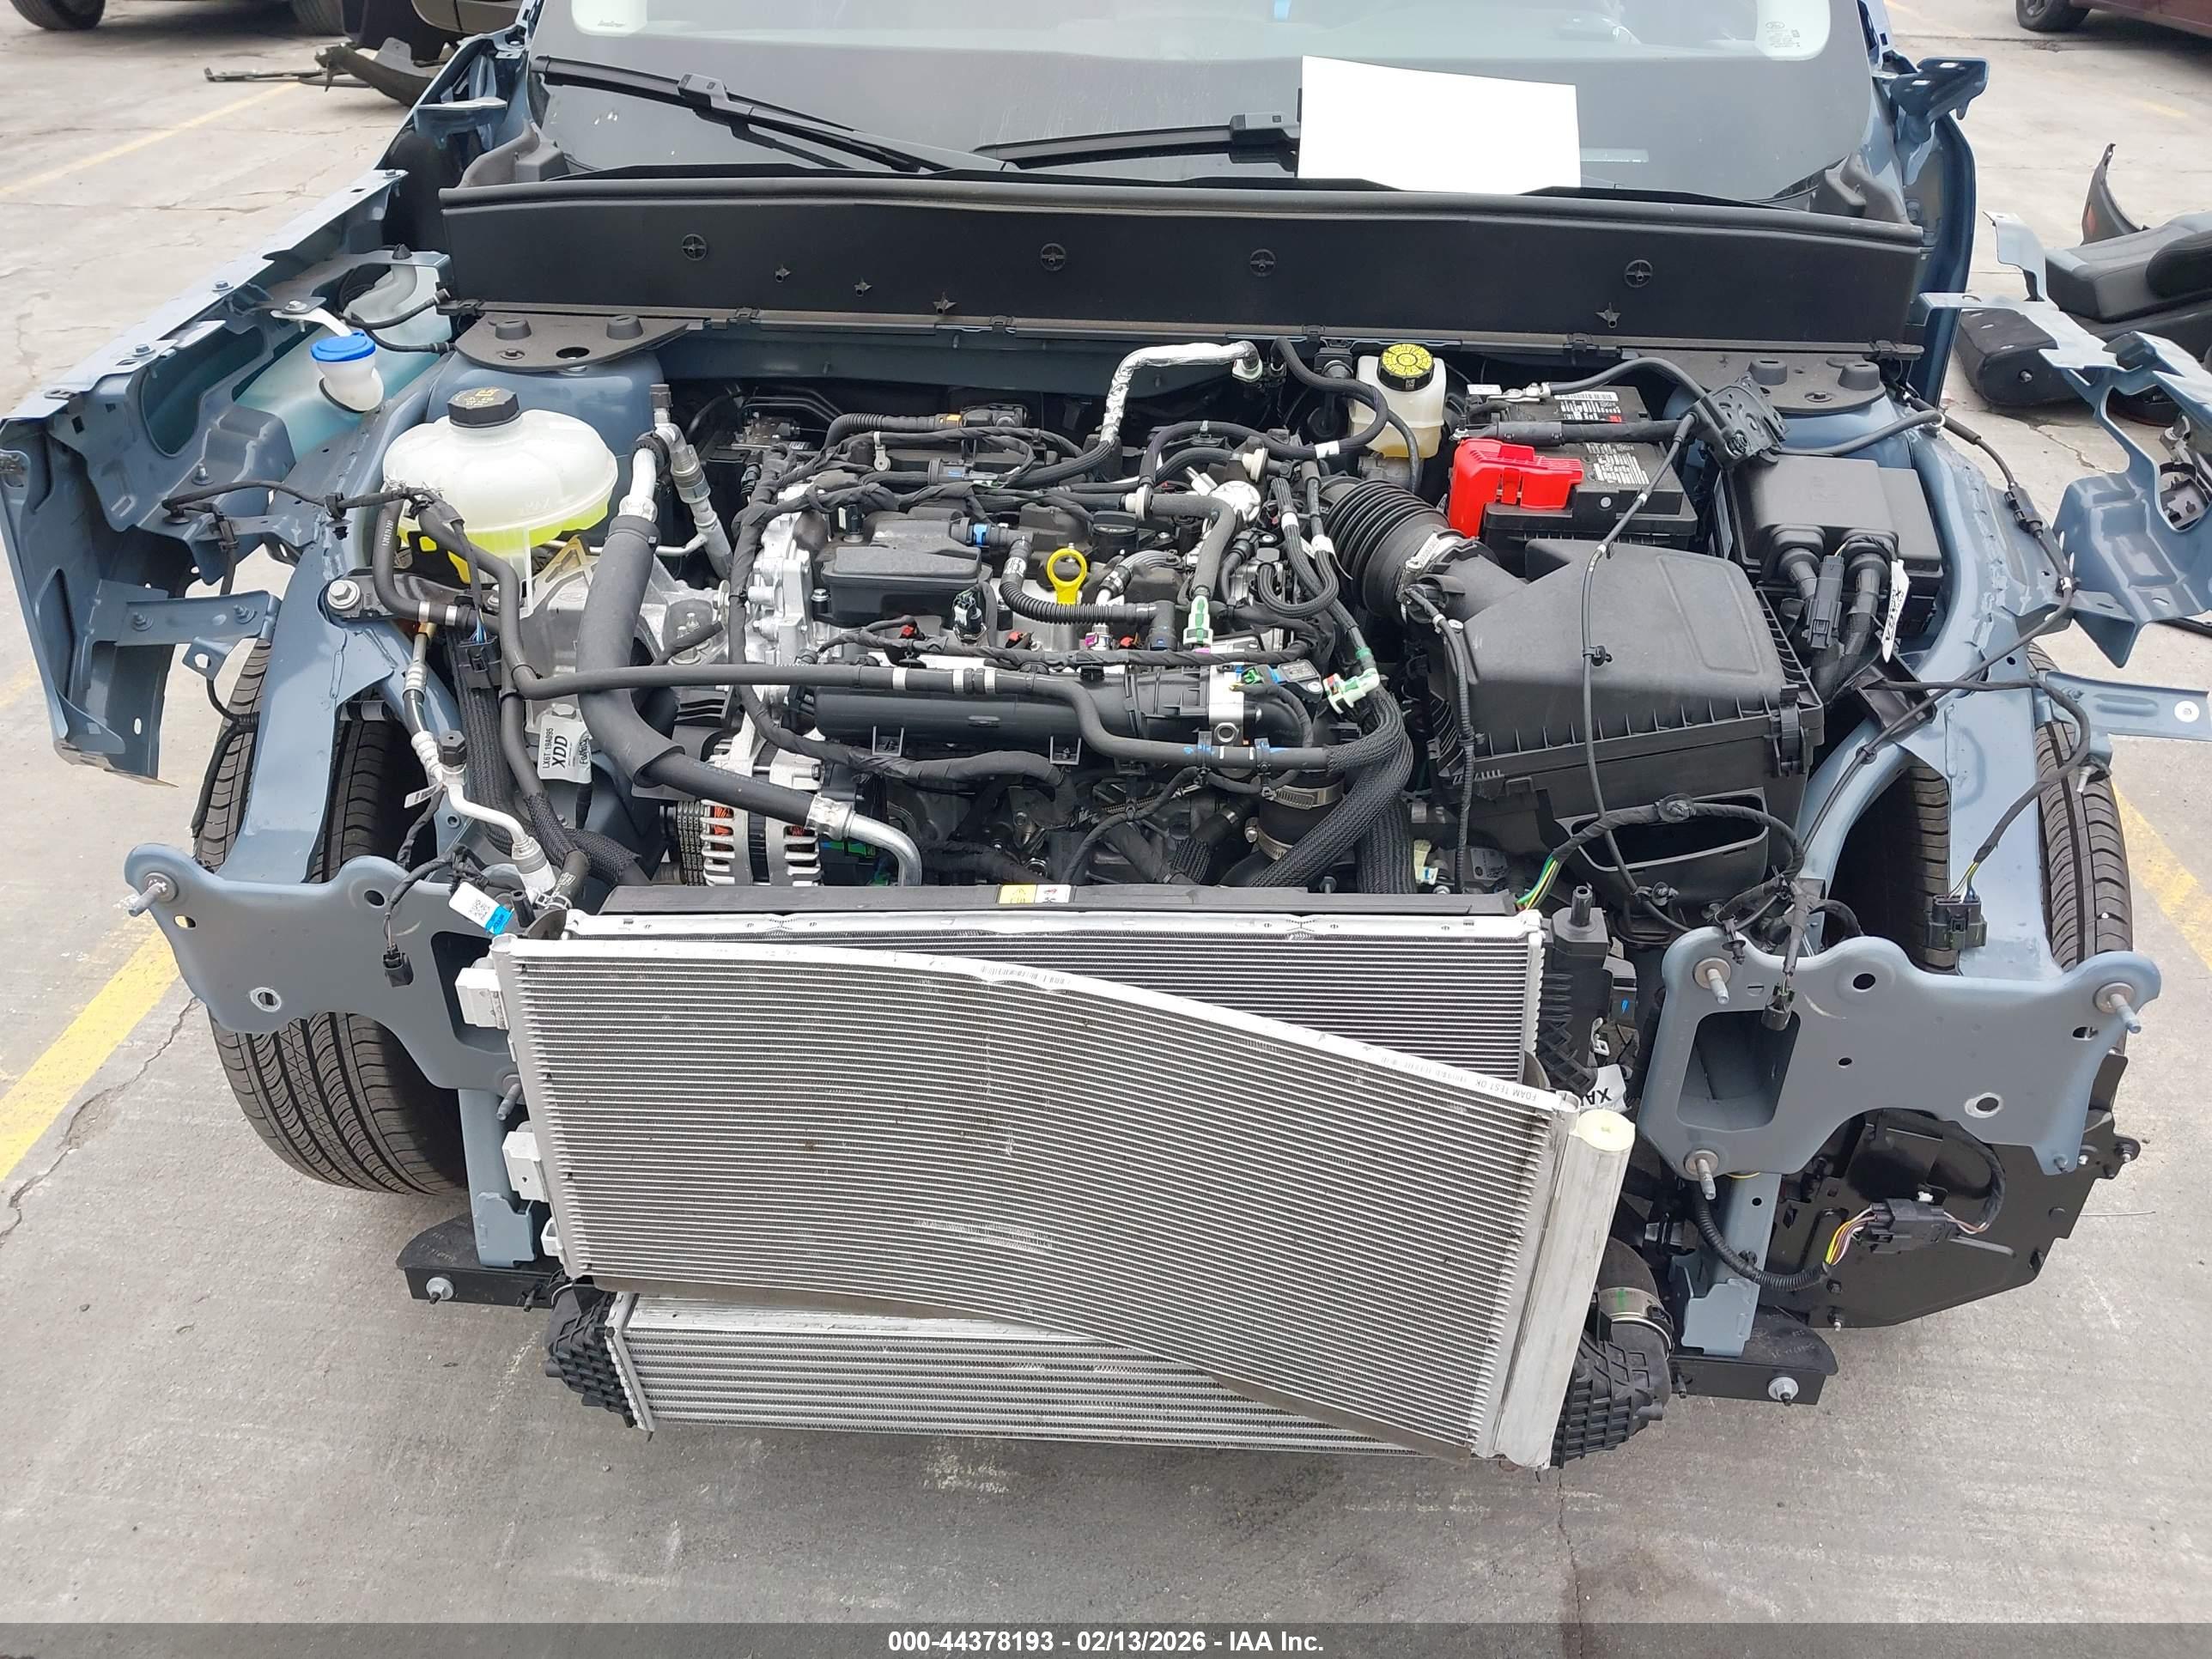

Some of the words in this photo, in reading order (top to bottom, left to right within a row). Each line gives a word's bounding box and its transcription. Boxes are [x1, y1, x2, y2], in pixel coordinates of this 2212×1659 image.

[552, 735, 568, 769] XDD
[1490, 1083, 1509, 1095] TEST
[1512, 1085, 1537, 1102] FOAM
